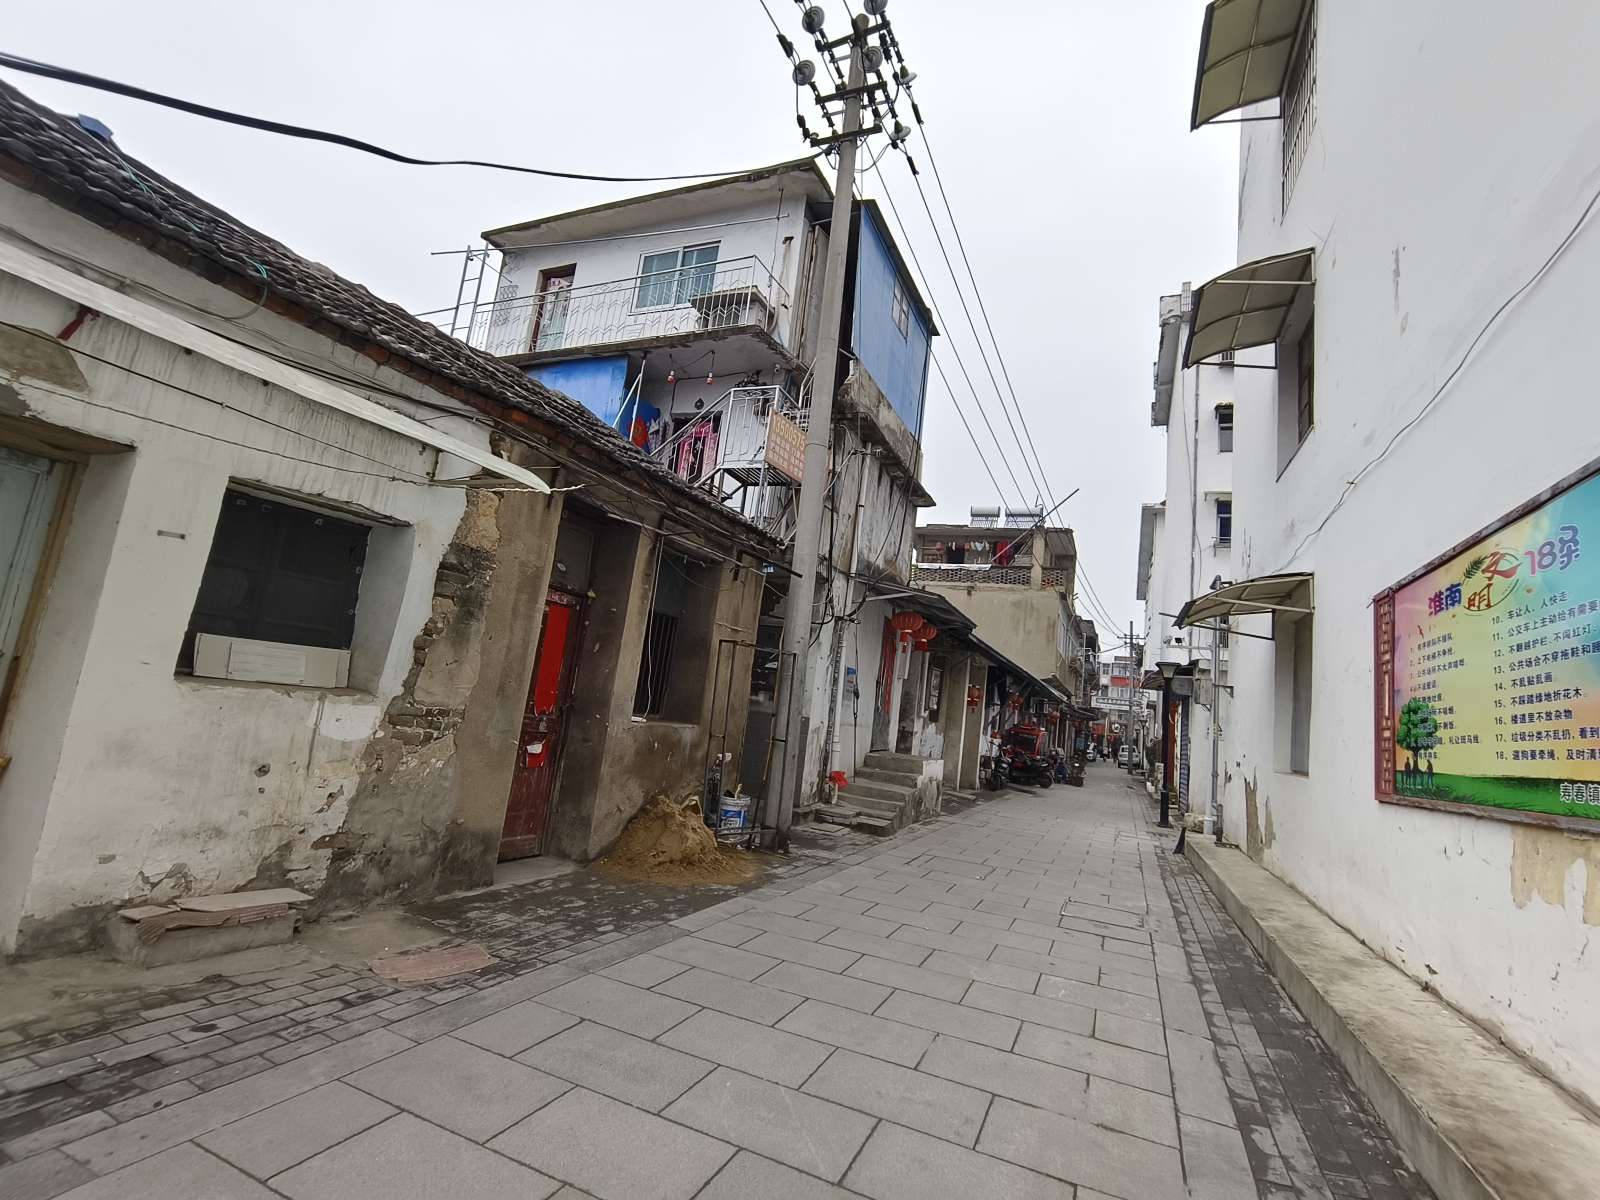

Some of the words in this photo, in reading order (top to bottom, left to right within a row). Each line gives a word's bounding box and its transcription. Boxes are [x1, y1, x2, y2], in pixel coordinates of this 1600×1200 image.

[1428, 582, 1462, 616] 淮南
[1524, 524, 1580, 576] 18条
[1492, 600, 1600, 640] 11、公交车上主动给有需要
[1560, 782, 1600, 805] 寿春镇
